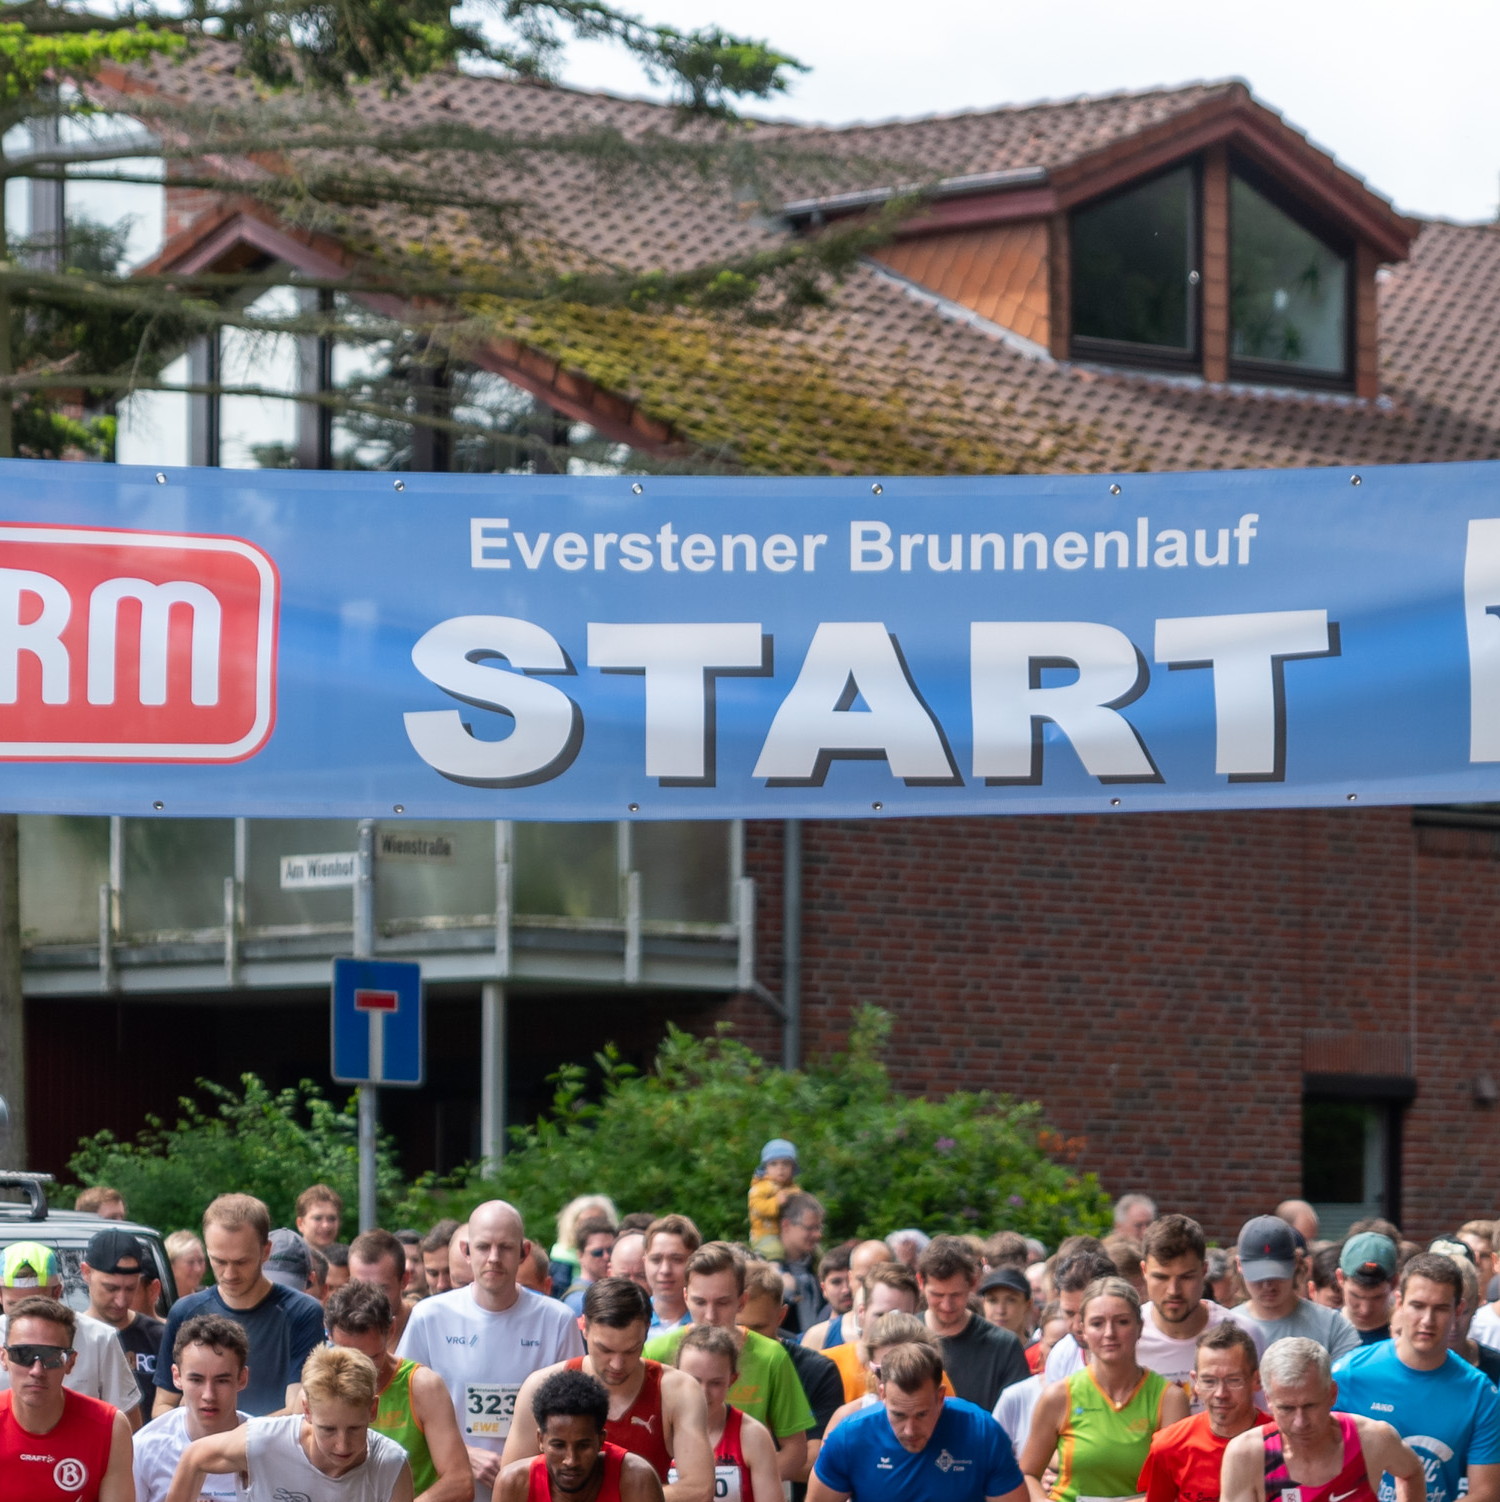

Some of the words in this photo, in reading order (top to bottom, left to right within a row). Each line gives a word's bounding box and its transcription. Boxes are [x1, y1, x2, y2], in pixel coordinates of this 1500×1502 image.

[470, 517, 828, 573] Everstener
[850, 514, 1258, 572] Brunnenlauf
[404, 609, 1336, 785] START
[382, 835, 451, 856] Wienstraße
[286, 861, 303, 879] Am
[307, 857, 354, 877] Wienhof
[446, 1335, 466, 1345] VRG
[520, 1338, 540, 1347] Lars
[468, 1393, 518, 1415] 323
[1370, 1402, 1395, 1413] JAKO
[472, 1422, 500, 1432] EWE
[20, 1453, 47, 1462] CRAFT
